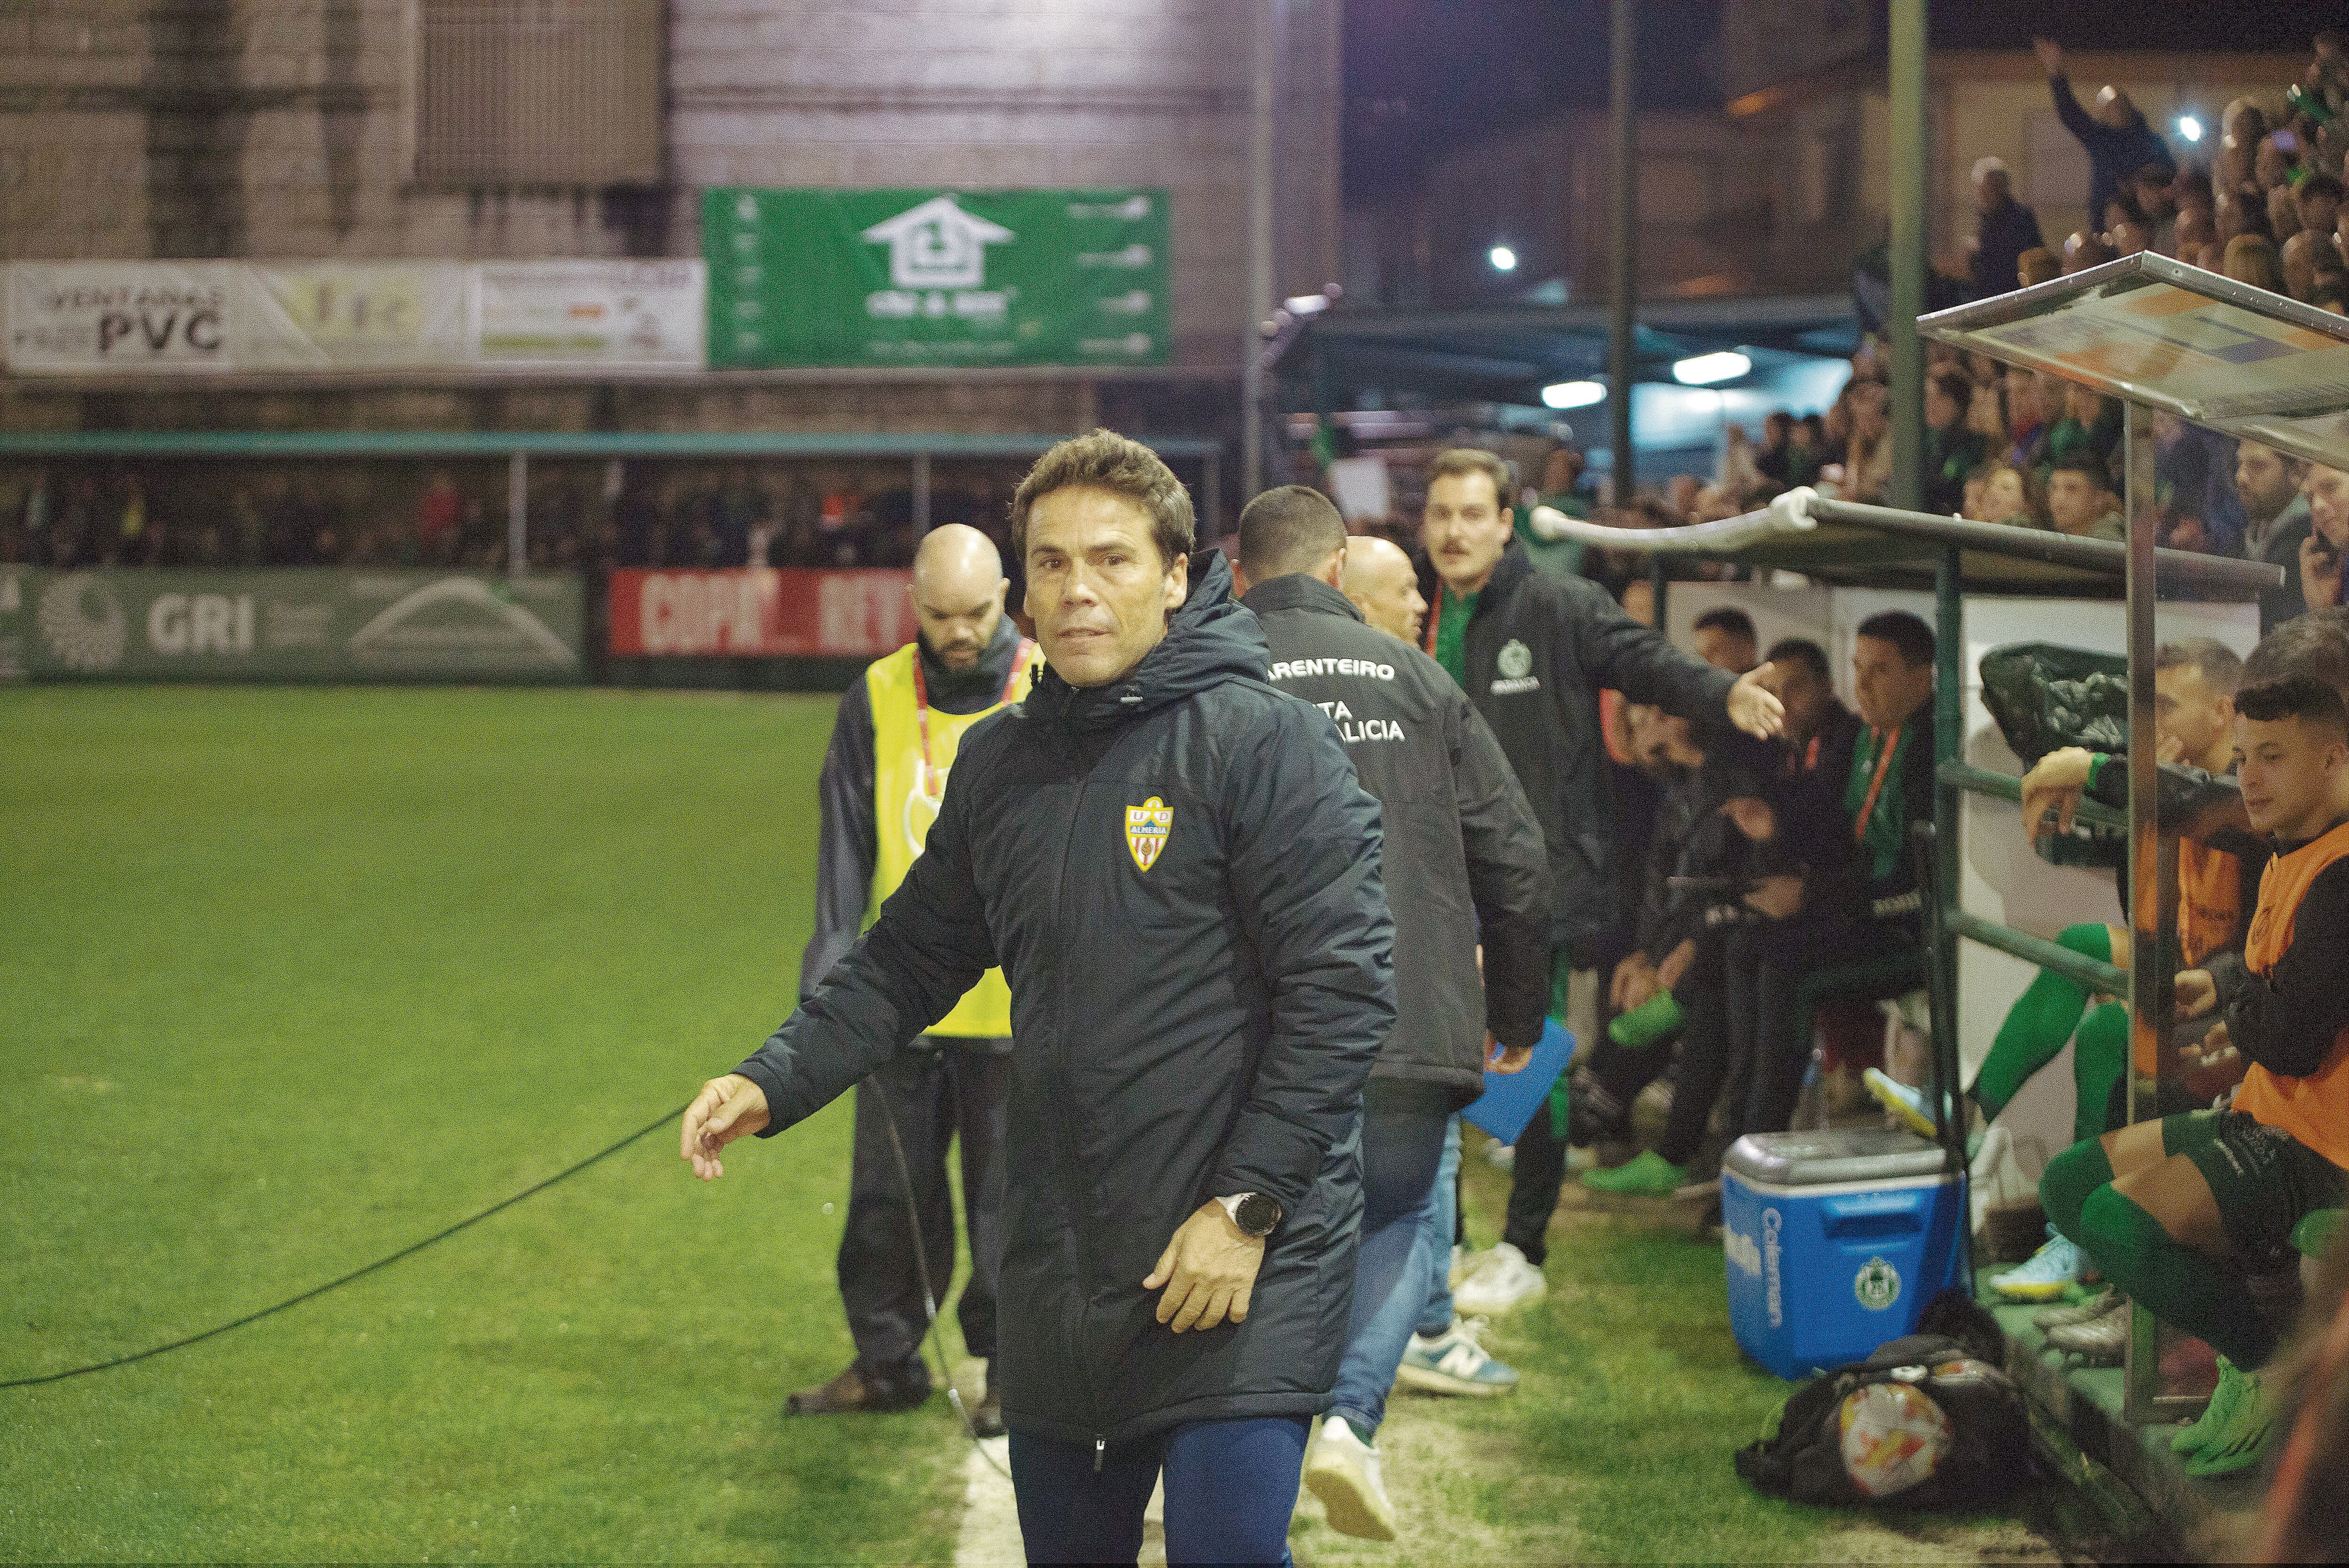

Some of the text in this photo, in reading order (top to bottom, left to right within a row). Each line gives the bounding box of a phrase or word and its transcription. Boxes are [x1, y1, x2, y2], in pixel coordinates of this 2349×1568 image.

[98, 311, 224, 354] PVC
[148, 593, 257, 654] GRI
[1312, 700, 1353, 721] TA
[1134, 811, 1168, 821] U D
